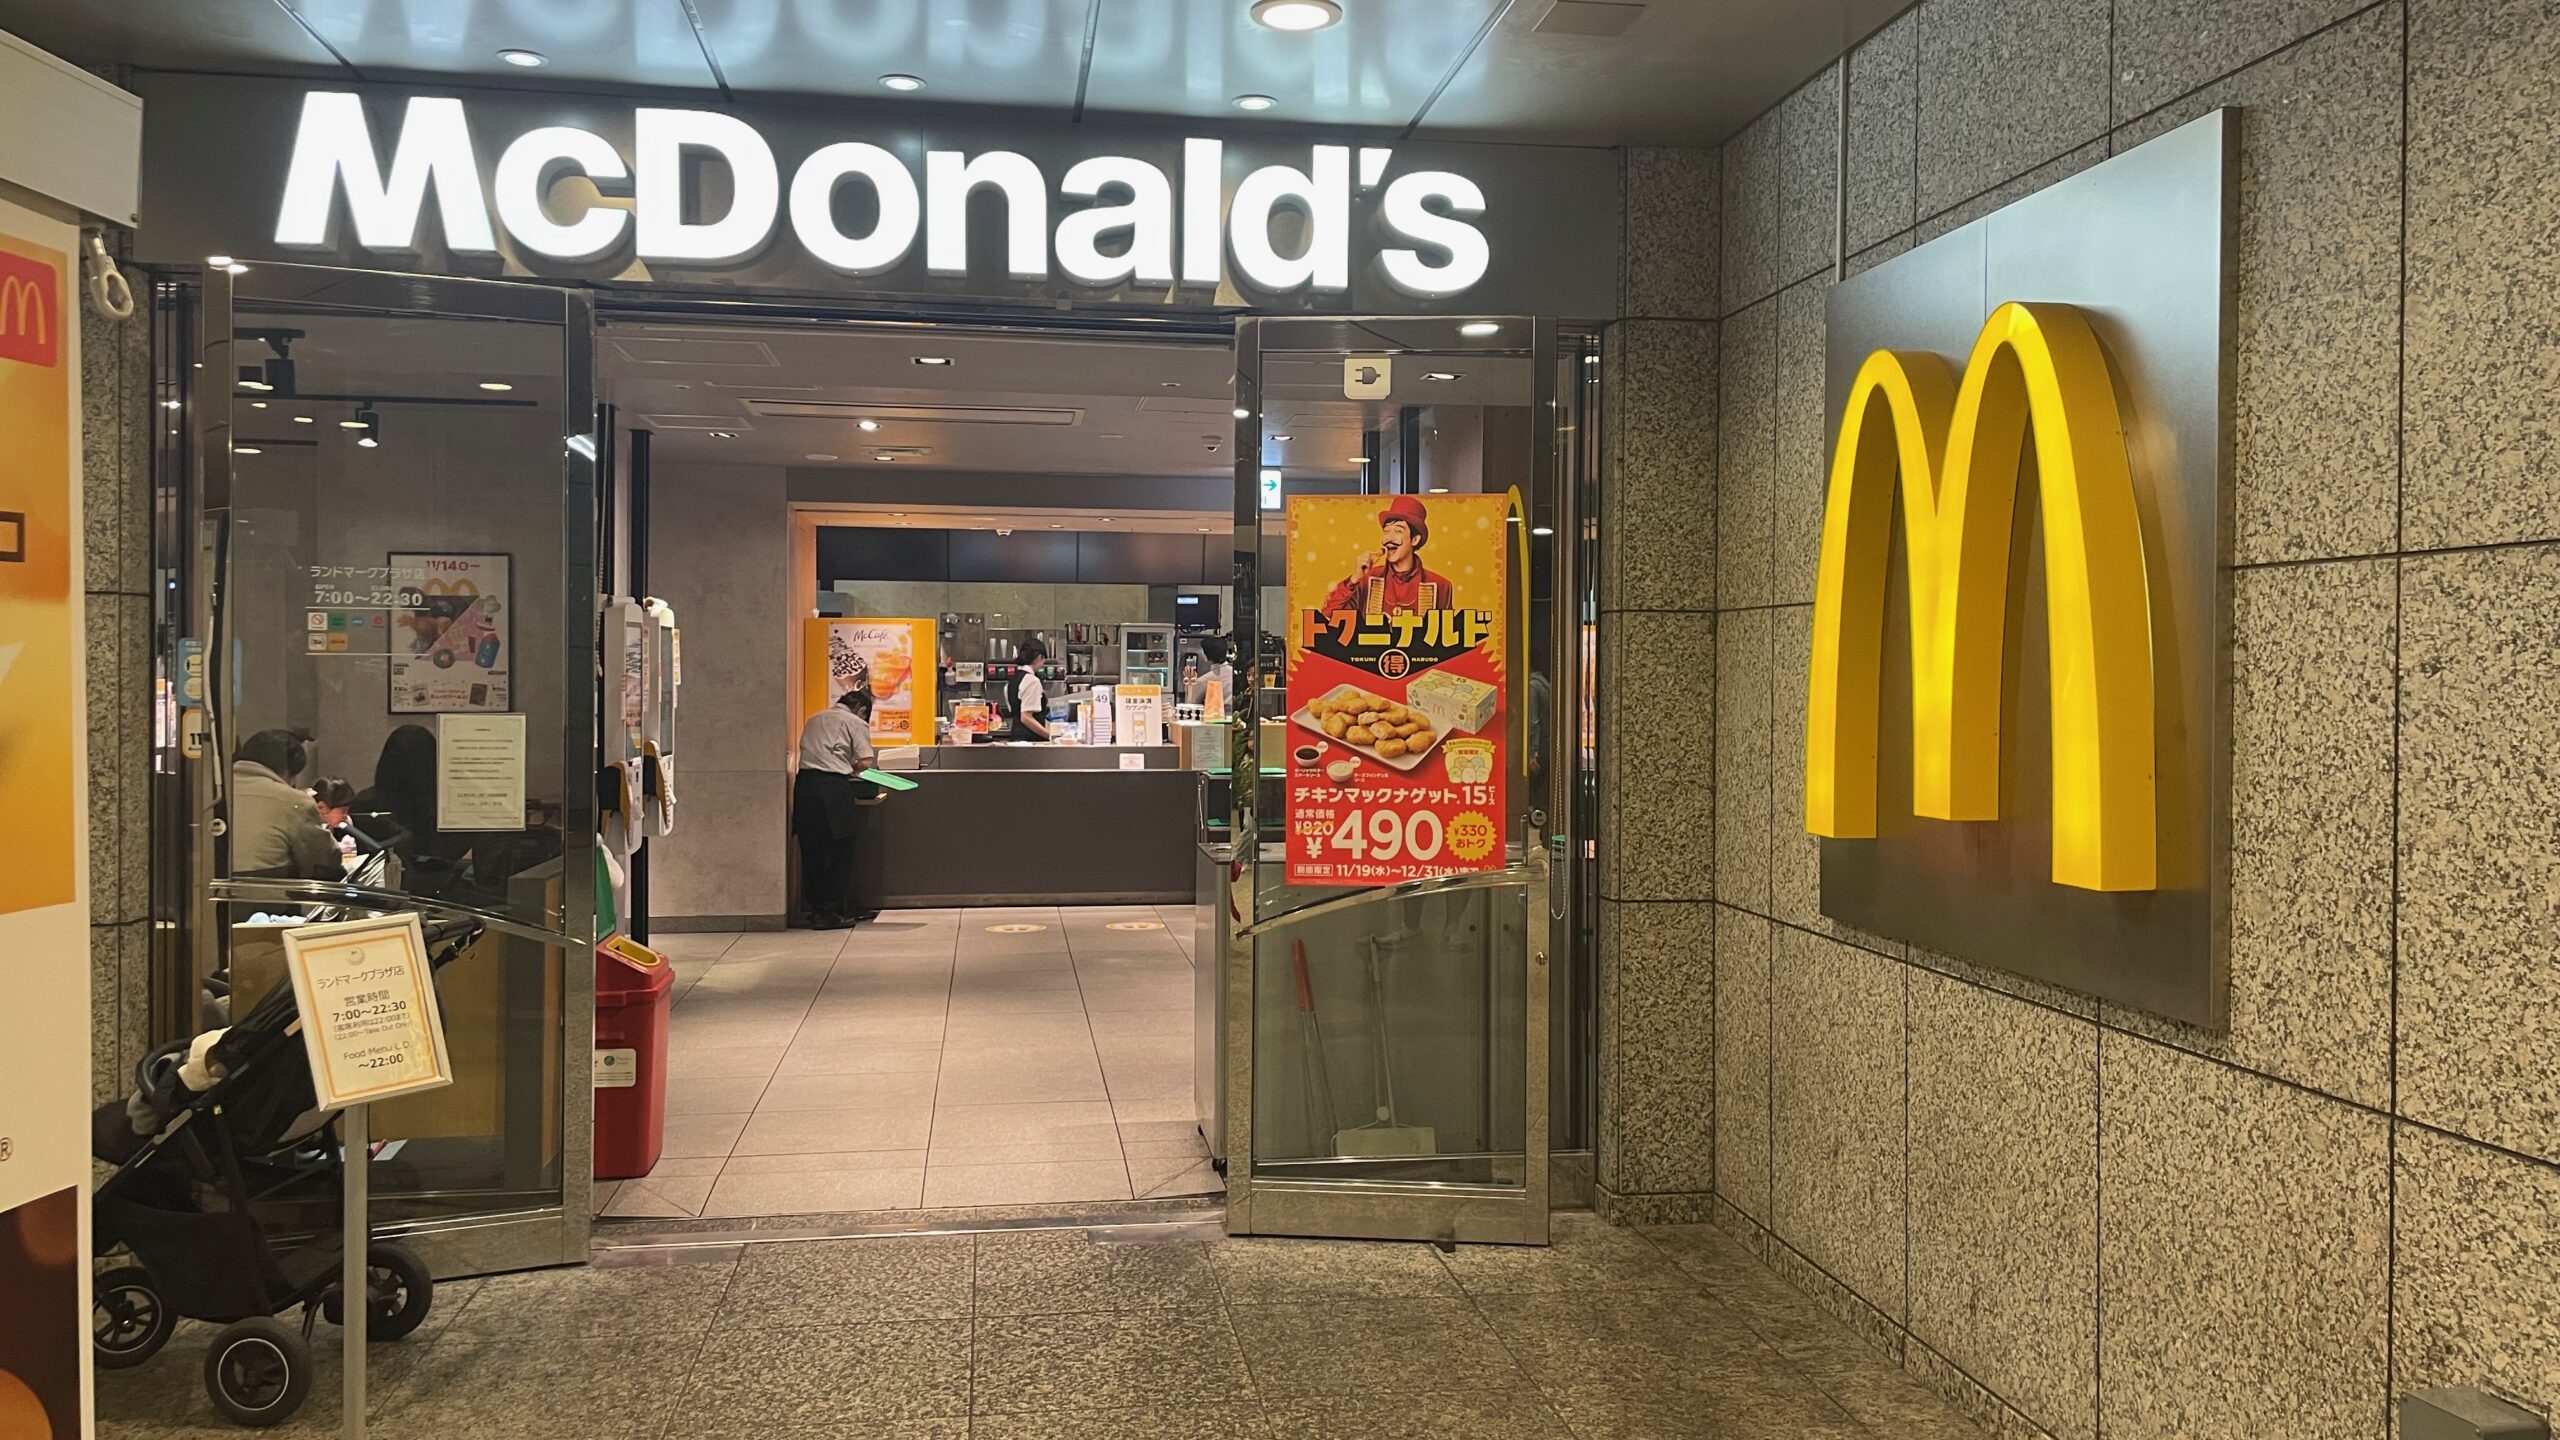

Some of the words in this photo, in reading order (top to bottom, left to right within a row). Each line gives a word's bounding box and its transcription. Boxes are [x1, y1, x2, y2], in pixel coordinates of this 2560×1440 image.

[275, 90, 1490, 294] McDonald's
[310, 566, 424, 579] ランドマークプラザ店
[1302, 609, 1492, 648] トクニナルド
[1383, 655, 1405, 673] 得
[1095, 694, 1108, 704] 49
[1295, 808, 1335, 819] 通常価格
[1454, 824, 1487, 836] ¥330
[1456, 839, 1486, 848] おトク
[317, 965, 404, 989] ランドマークプラザ店
[344, 989, 390, 1006] 営業時間
[344, 1049, 367, 1060] Food
[369, 1044, 392, 1055] Menu
